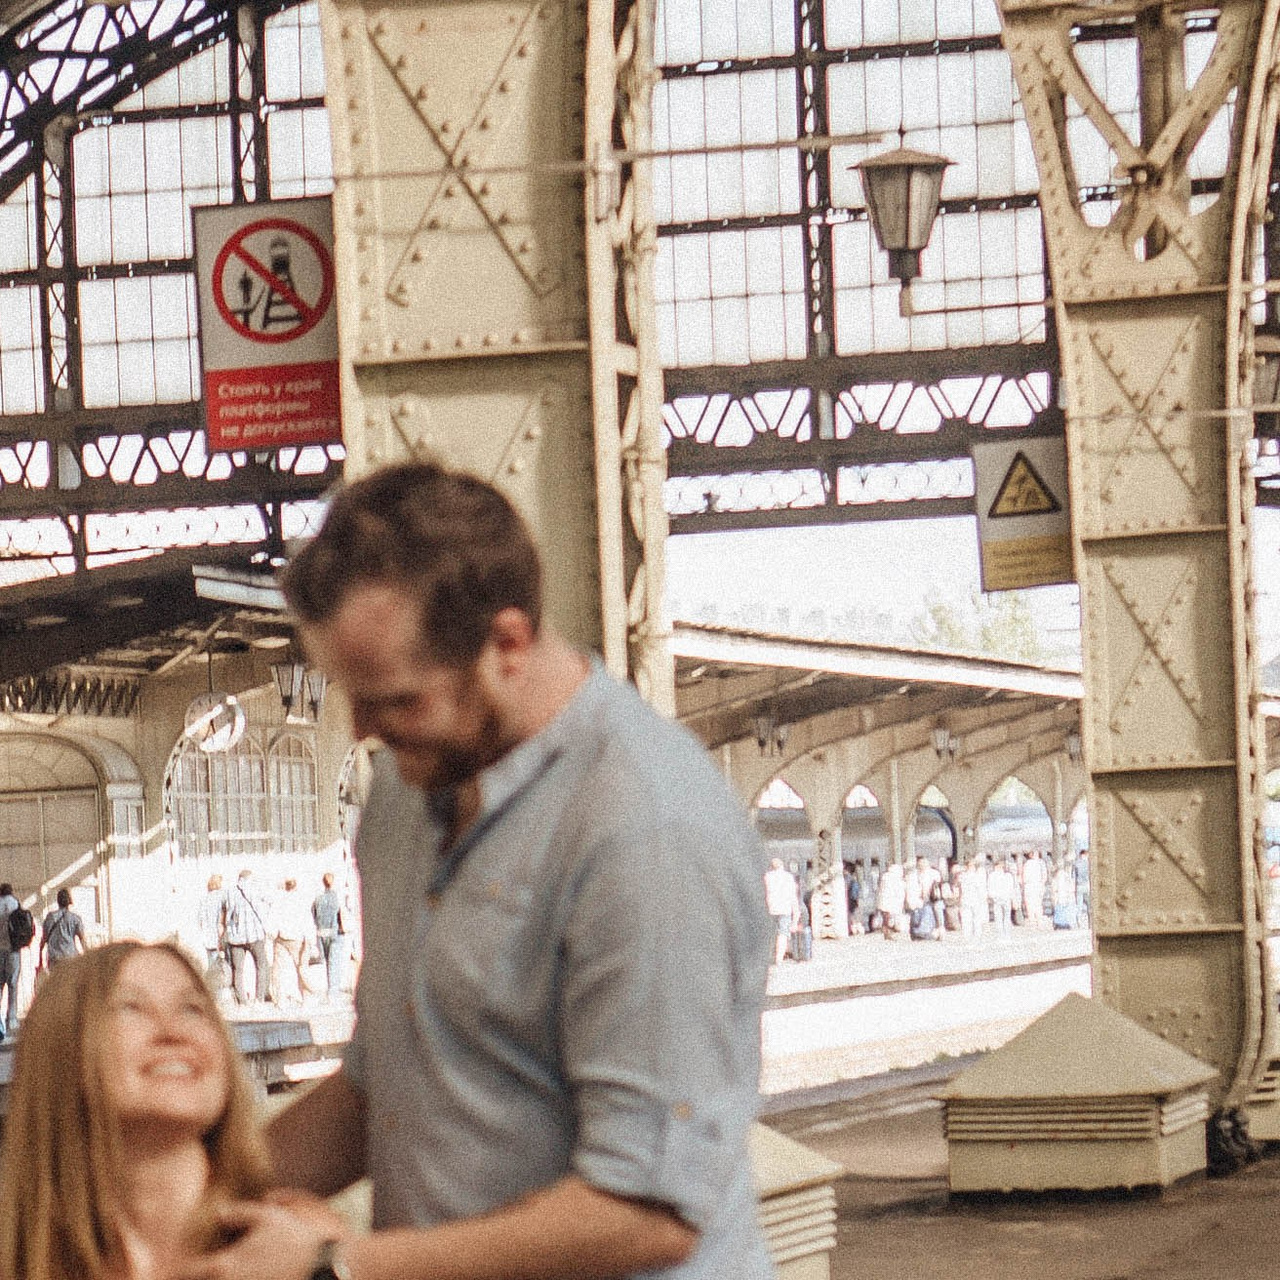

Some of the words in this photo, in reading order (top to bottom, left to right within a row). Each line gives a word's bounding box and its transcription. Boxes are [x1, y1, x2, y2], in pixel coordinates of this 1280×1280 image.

[218, 382, 270, 399] Стоять
[272, 382, 282, 399] у
[219, 400, 311, 418] платформы
[220, 425, 239, 438] не
